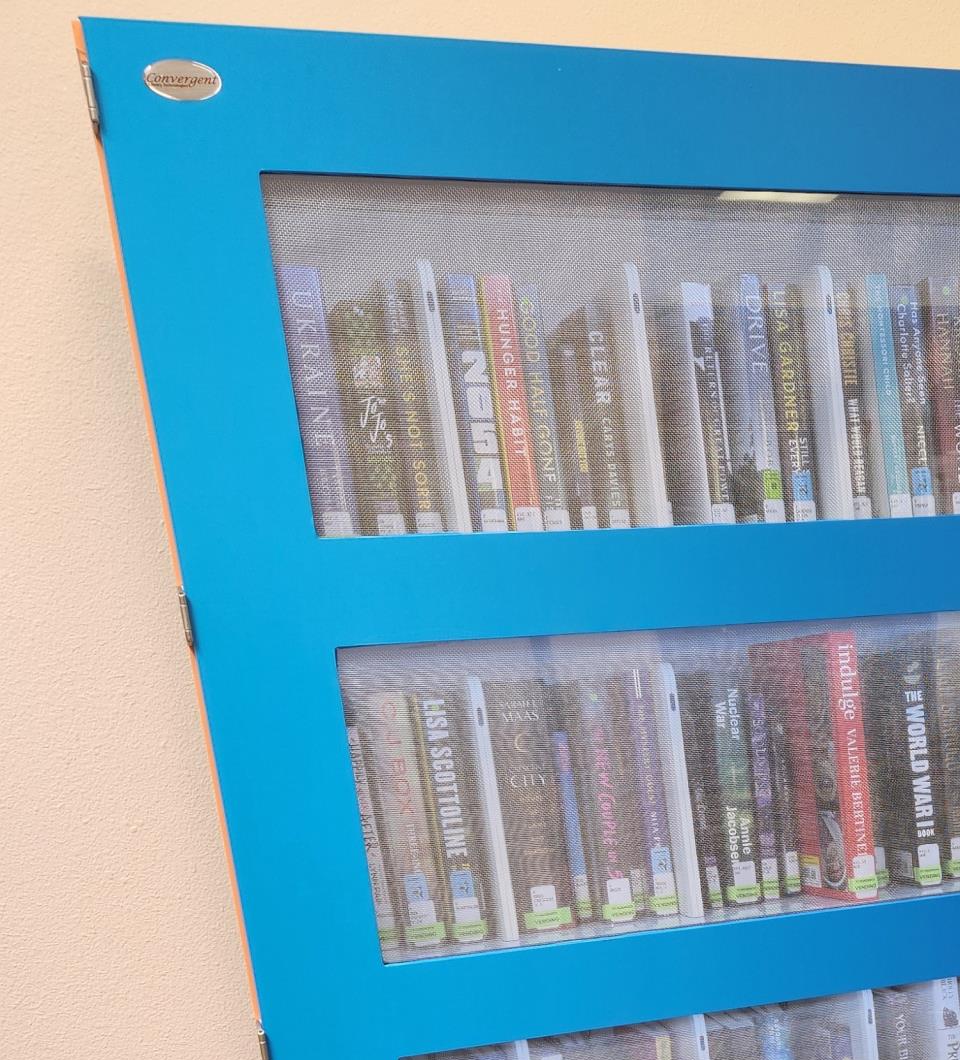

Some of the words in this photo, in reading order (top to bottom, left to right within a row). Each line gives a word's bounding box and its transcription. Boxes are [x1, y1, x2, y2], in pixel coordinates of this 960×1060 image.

[147, 72, 216, 88] Convergent
[773, 290, 786, 332] LISA
[837, 291, 852, 327] CHRIS
[519, 301, 540, 364] GOOD
[746, 294, 768, 375] DRIVE
[896, 303, 911, 360] Charlotte
[911, 326, 924, 369] Anyone
[936, 313, 954, 390] HANNAH
[291, 290, 336, 447] UKRAINE
[395, 345, 415, 403] SHE'S
[588, 330, 611, 405] CLEAR
[840, 331, 858, 386] CHRISTIE
[495, 308, 517, 391] HUNGER
[507, 398, 528, 457] HABIT
[529, 371, 547, 417] HALF
[779, 341, 800, 432] GARDNER
[916, 371, 927, 406] Seen
[404, 409, 424, 451] NOT
[848, 398, 859, 423] WHAT
[798, 437, 808, 466] STILL
[412, 459, 432, 511] SORR
[838, 644, 855, 721] indulge
[905, 690, 923, 702] THE
[423, 699, 449, 742] LISA
[501, 710, 540, 722] MAAS
[715, 701, 726, 730] War
[728, 688, 741, 740] Nuclear
[848, 728, 861, 788] VALERIE
[906, 703, 930, 774] WORLD
[392, 757, 415, 816] BOX
[510, 775, 548, 789] CITY
[594, 748, 615, 788] NEW
[431, 747, 468, 858] SCOTTOLINE
[912, 775, 934, 818] WAR
[738, 817, 751, 855] Annie
[851, 791, 869, 856] BERTINE
[916, 820, 935, 828] I
[917, 829, 935, 838] BOOK
[895, 1014, 907, 1049] YOUR
